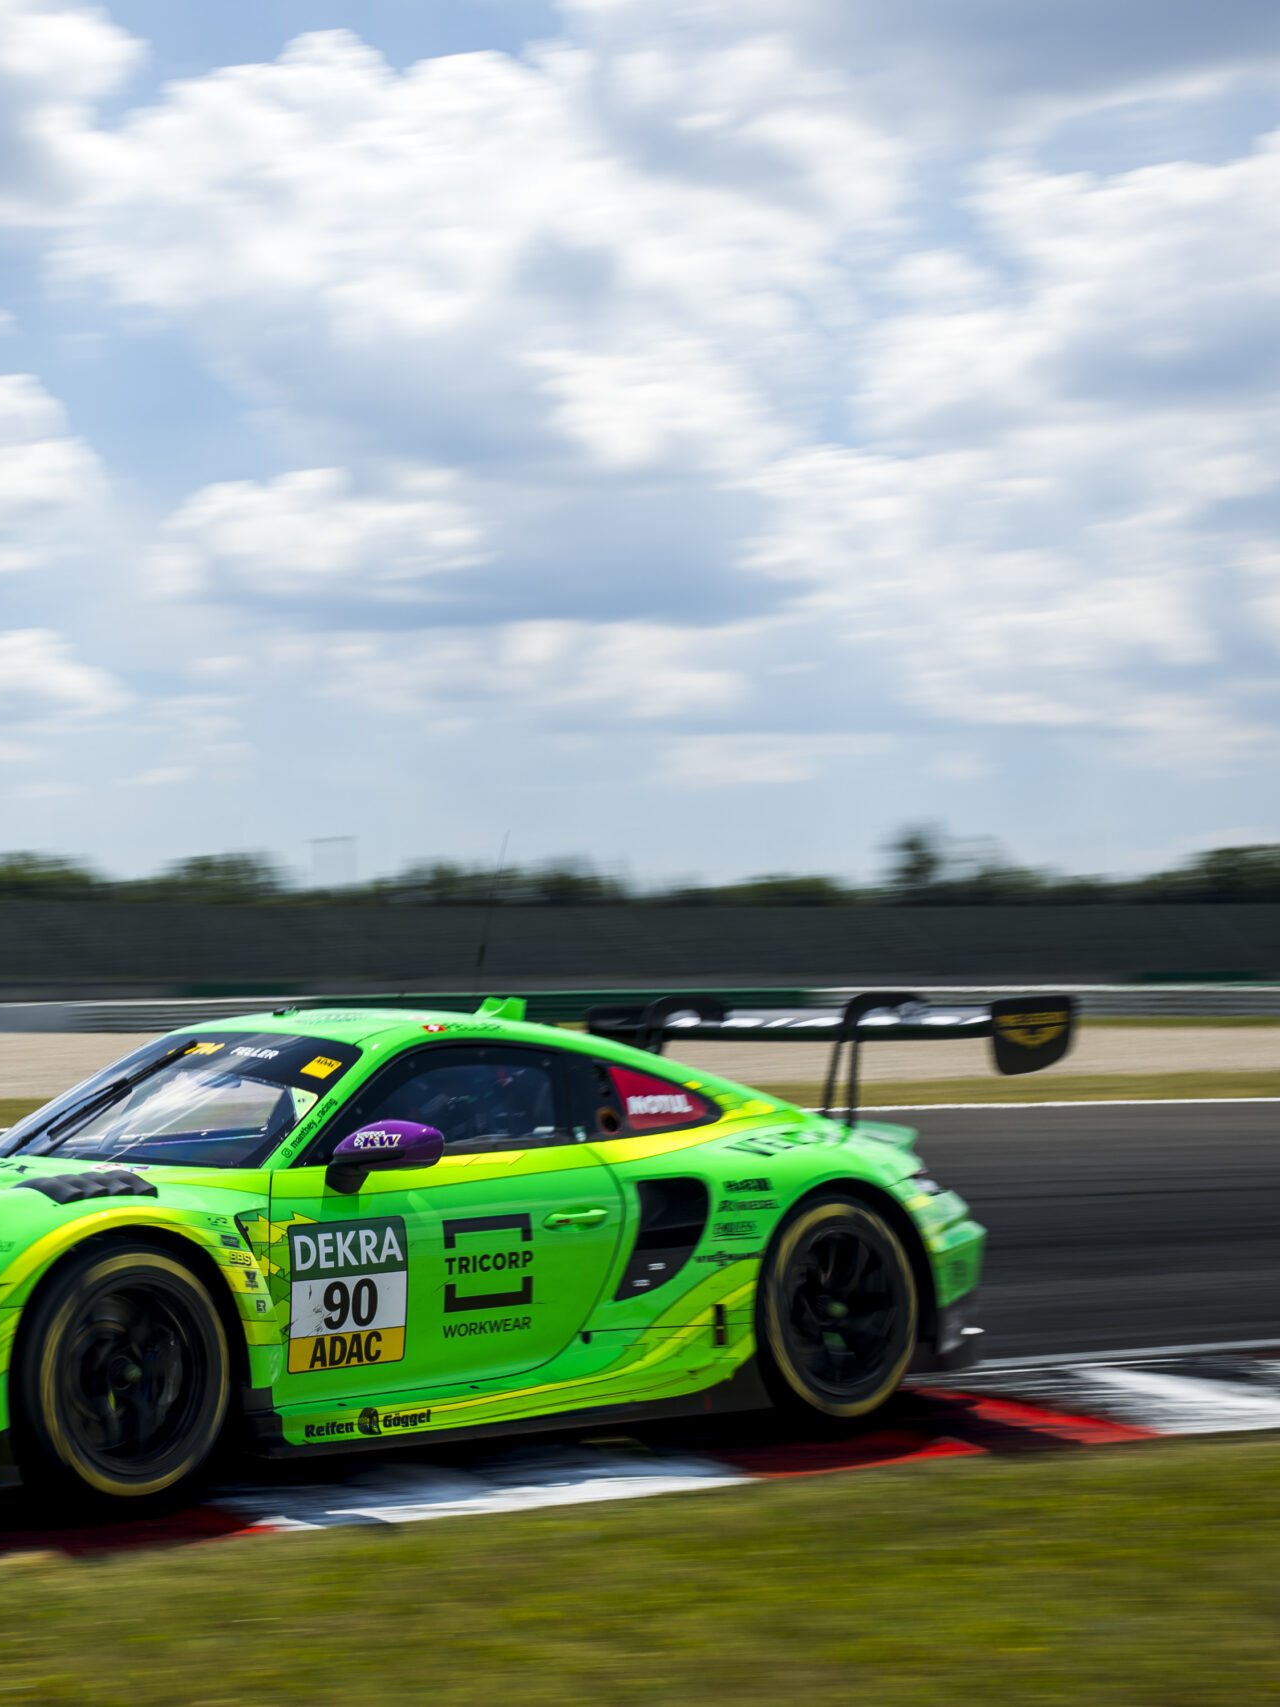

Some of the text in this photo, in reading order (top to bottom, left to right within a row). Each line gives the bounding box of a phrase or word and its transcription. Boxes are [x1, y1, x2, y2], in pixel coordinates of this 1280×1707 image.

[230, 1046, 280, 1060] FELLER
[316, 1057, 340, 1069] ADAC
[626, 1094, 694, 1116] MOTUL
[290, 1097, 339, 1150] manthey_racing
[361, 1133, 402, 1150] KW
[229, 1250, 252, 1267] BBS
[293, 1226, 404, 1271] DEKRA
[445, 1250, 534, 1276] TRICORP
[323, 1278, 378, 1331] 90
[443, 1316, 532, 1339] WORKWEAR
[309, 1331, 383, 1369] ADAC
[304, 1409, 432, 1438] Reifen Göggel
